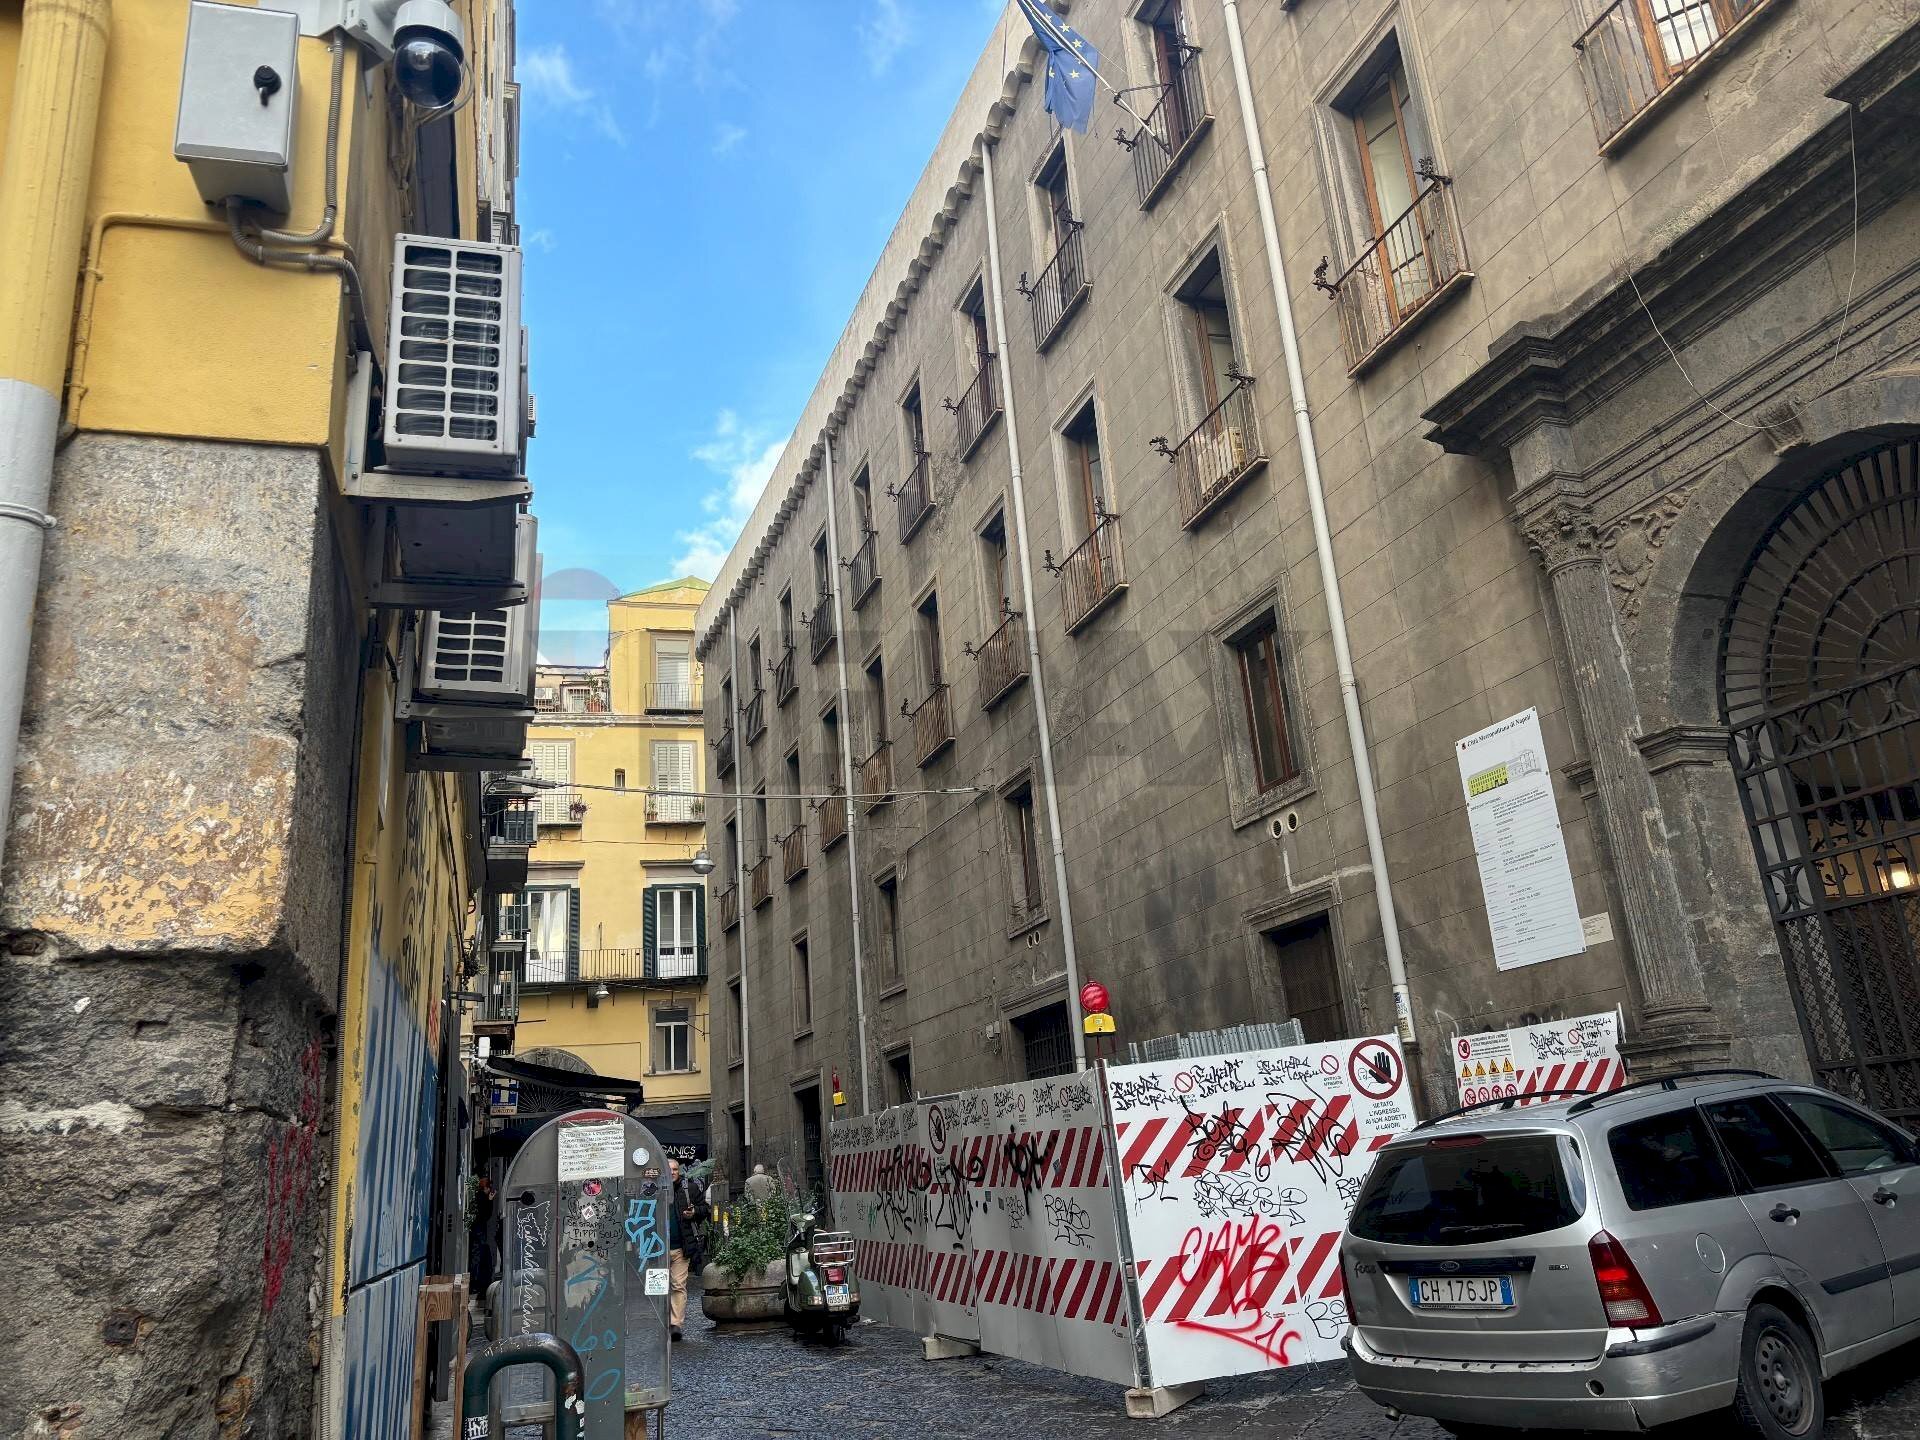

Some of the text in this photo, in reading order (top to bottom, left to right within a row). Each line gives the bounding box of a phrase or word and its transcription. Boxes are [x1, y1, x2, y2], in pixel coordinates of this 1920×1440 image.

[1372, 1101, 1394, 1109] VIETATO
[1368, 1107, 1401, 1117] L'INGRESSO
[1384, 1113, 1407, 1122] ADDETTI
[1380, 1122, 1401, 1130] LAVORI
[1420, 1280, 1441, 1302] CH
